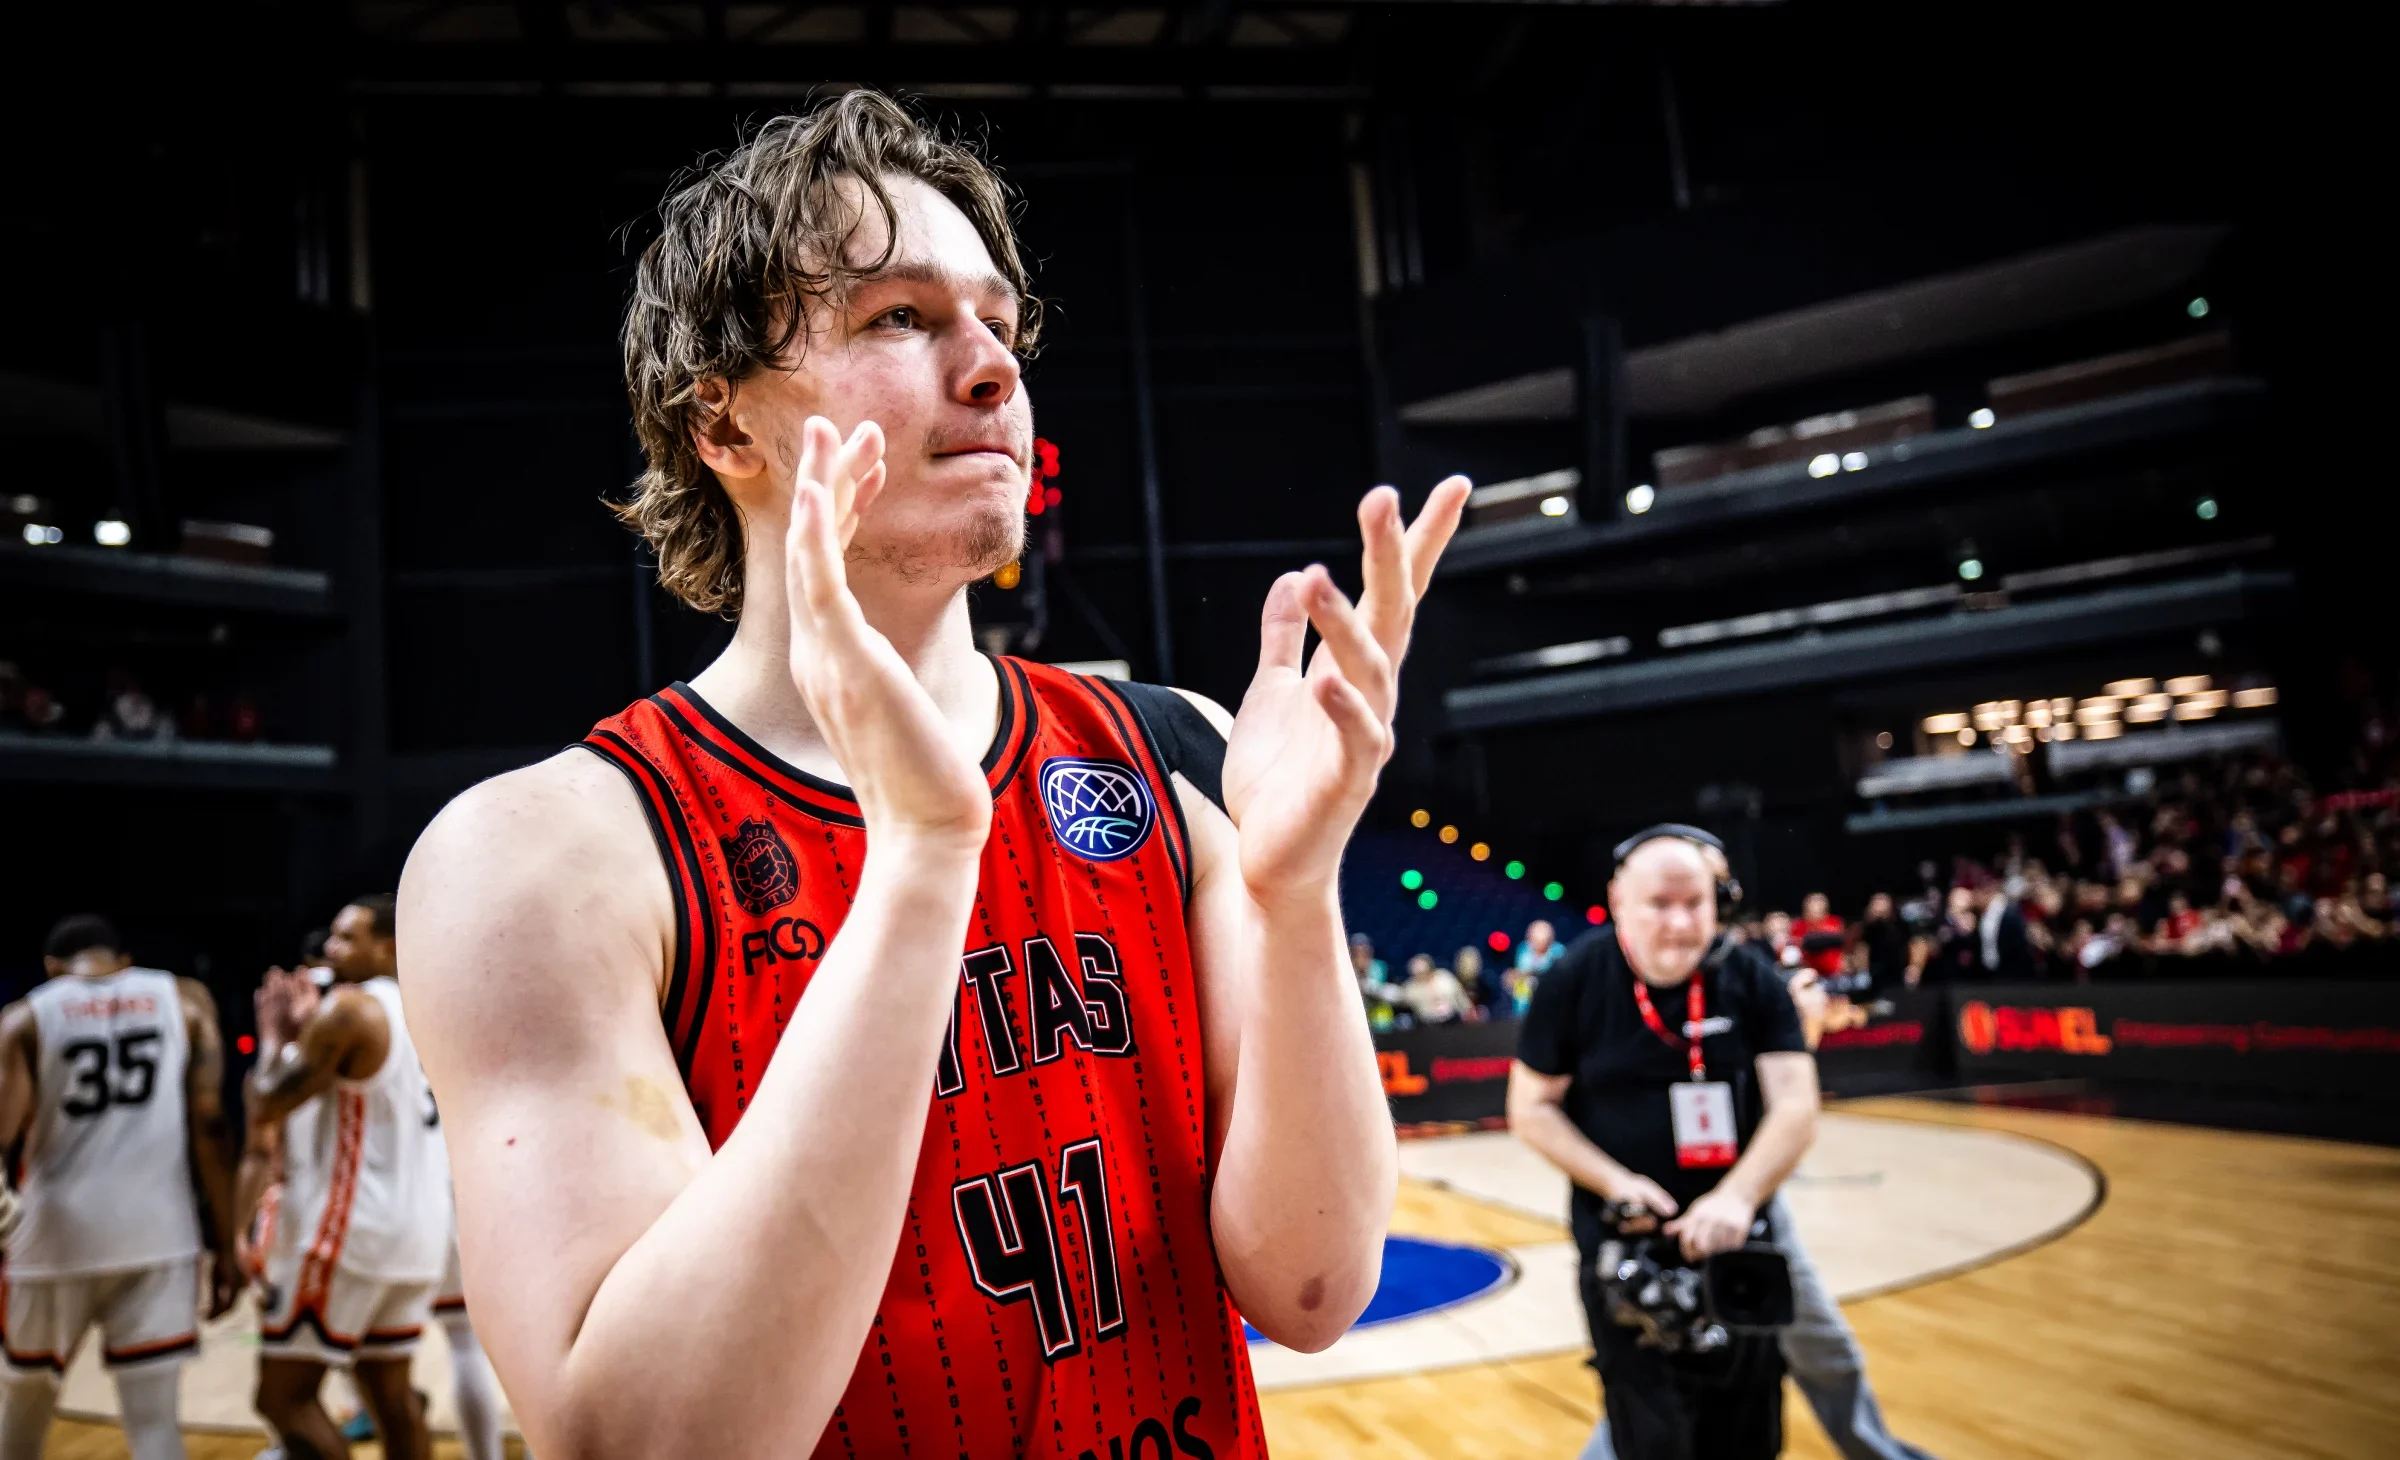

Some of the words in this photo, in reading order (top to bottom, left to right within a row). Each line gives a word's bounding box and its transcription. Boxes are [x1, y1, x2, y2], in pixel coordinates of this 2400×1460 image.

[727, 828, 777, 860] VILNIUS
[742, 882, 796, 913] RYTAS
[62, 1026, 163, 1119] 35
[952, 1134, 1128, 1364] 41
